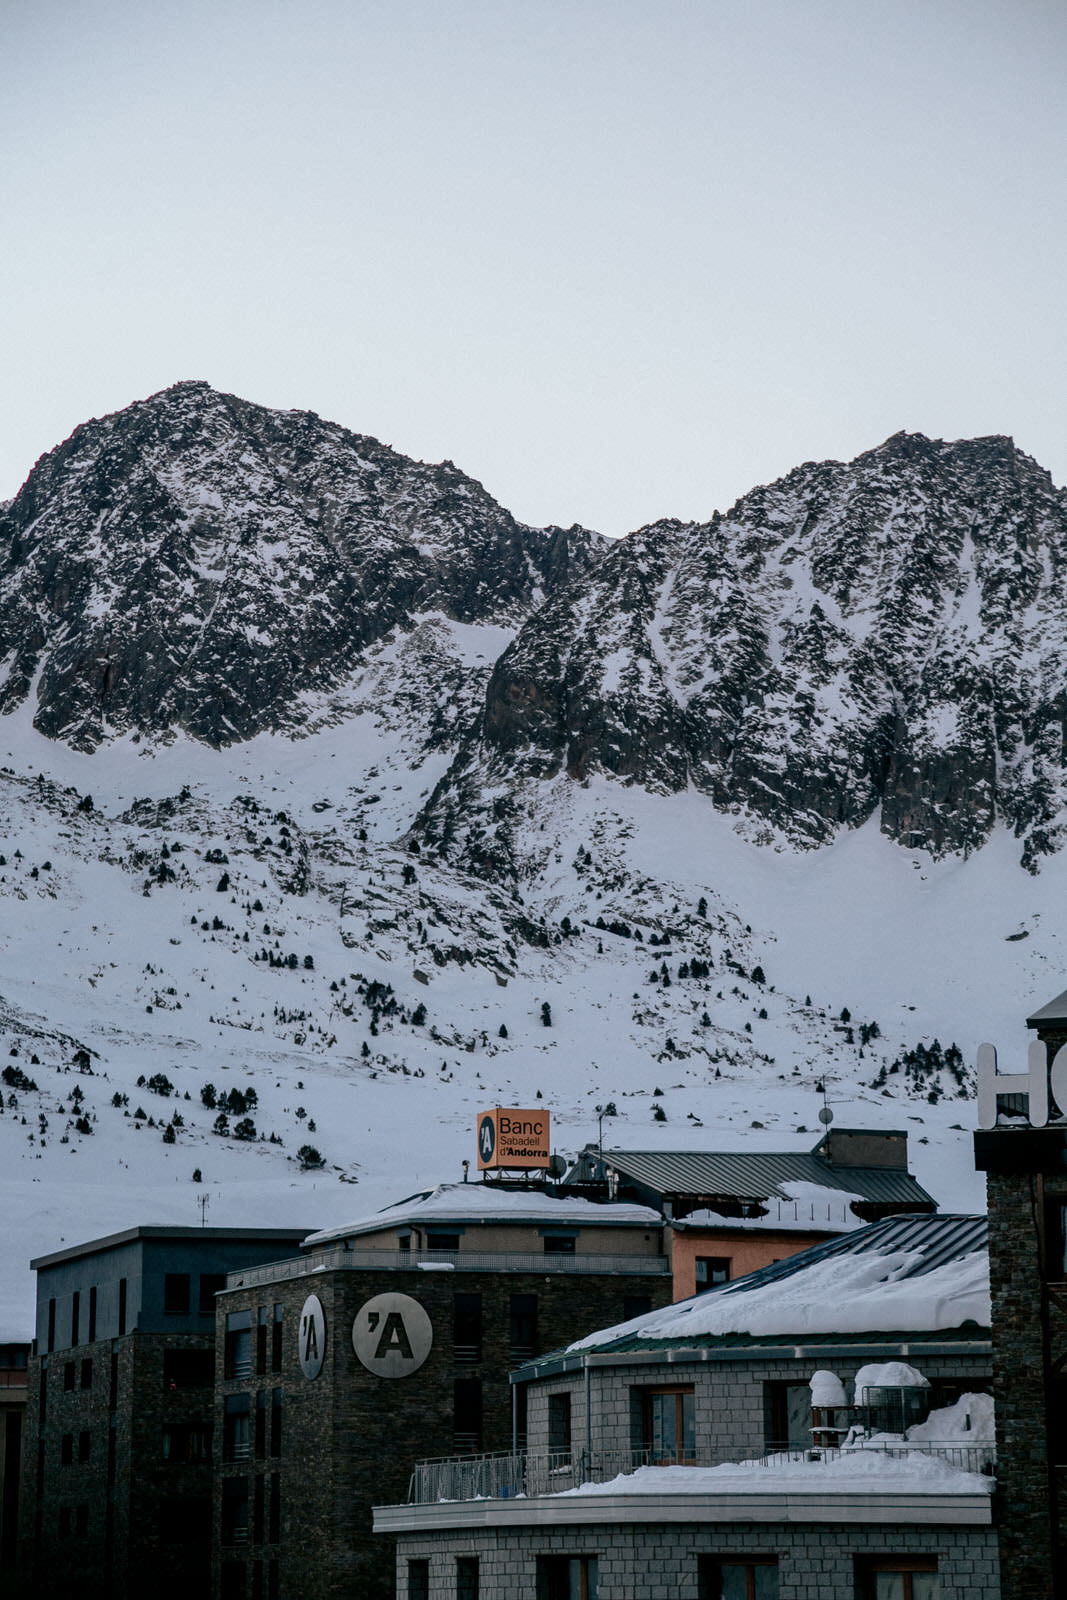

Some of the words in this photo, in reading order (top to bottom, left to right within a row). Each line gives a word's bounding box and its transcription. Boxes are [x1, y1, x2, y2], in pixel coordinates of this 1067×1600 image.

[977, 1040, 1067, 1129] H
[500, 1118, 543, 1135] Banc
[500, 1136, 540, 1145] Sabadell
[500, 1147, 548, 1157] d'Andorra
